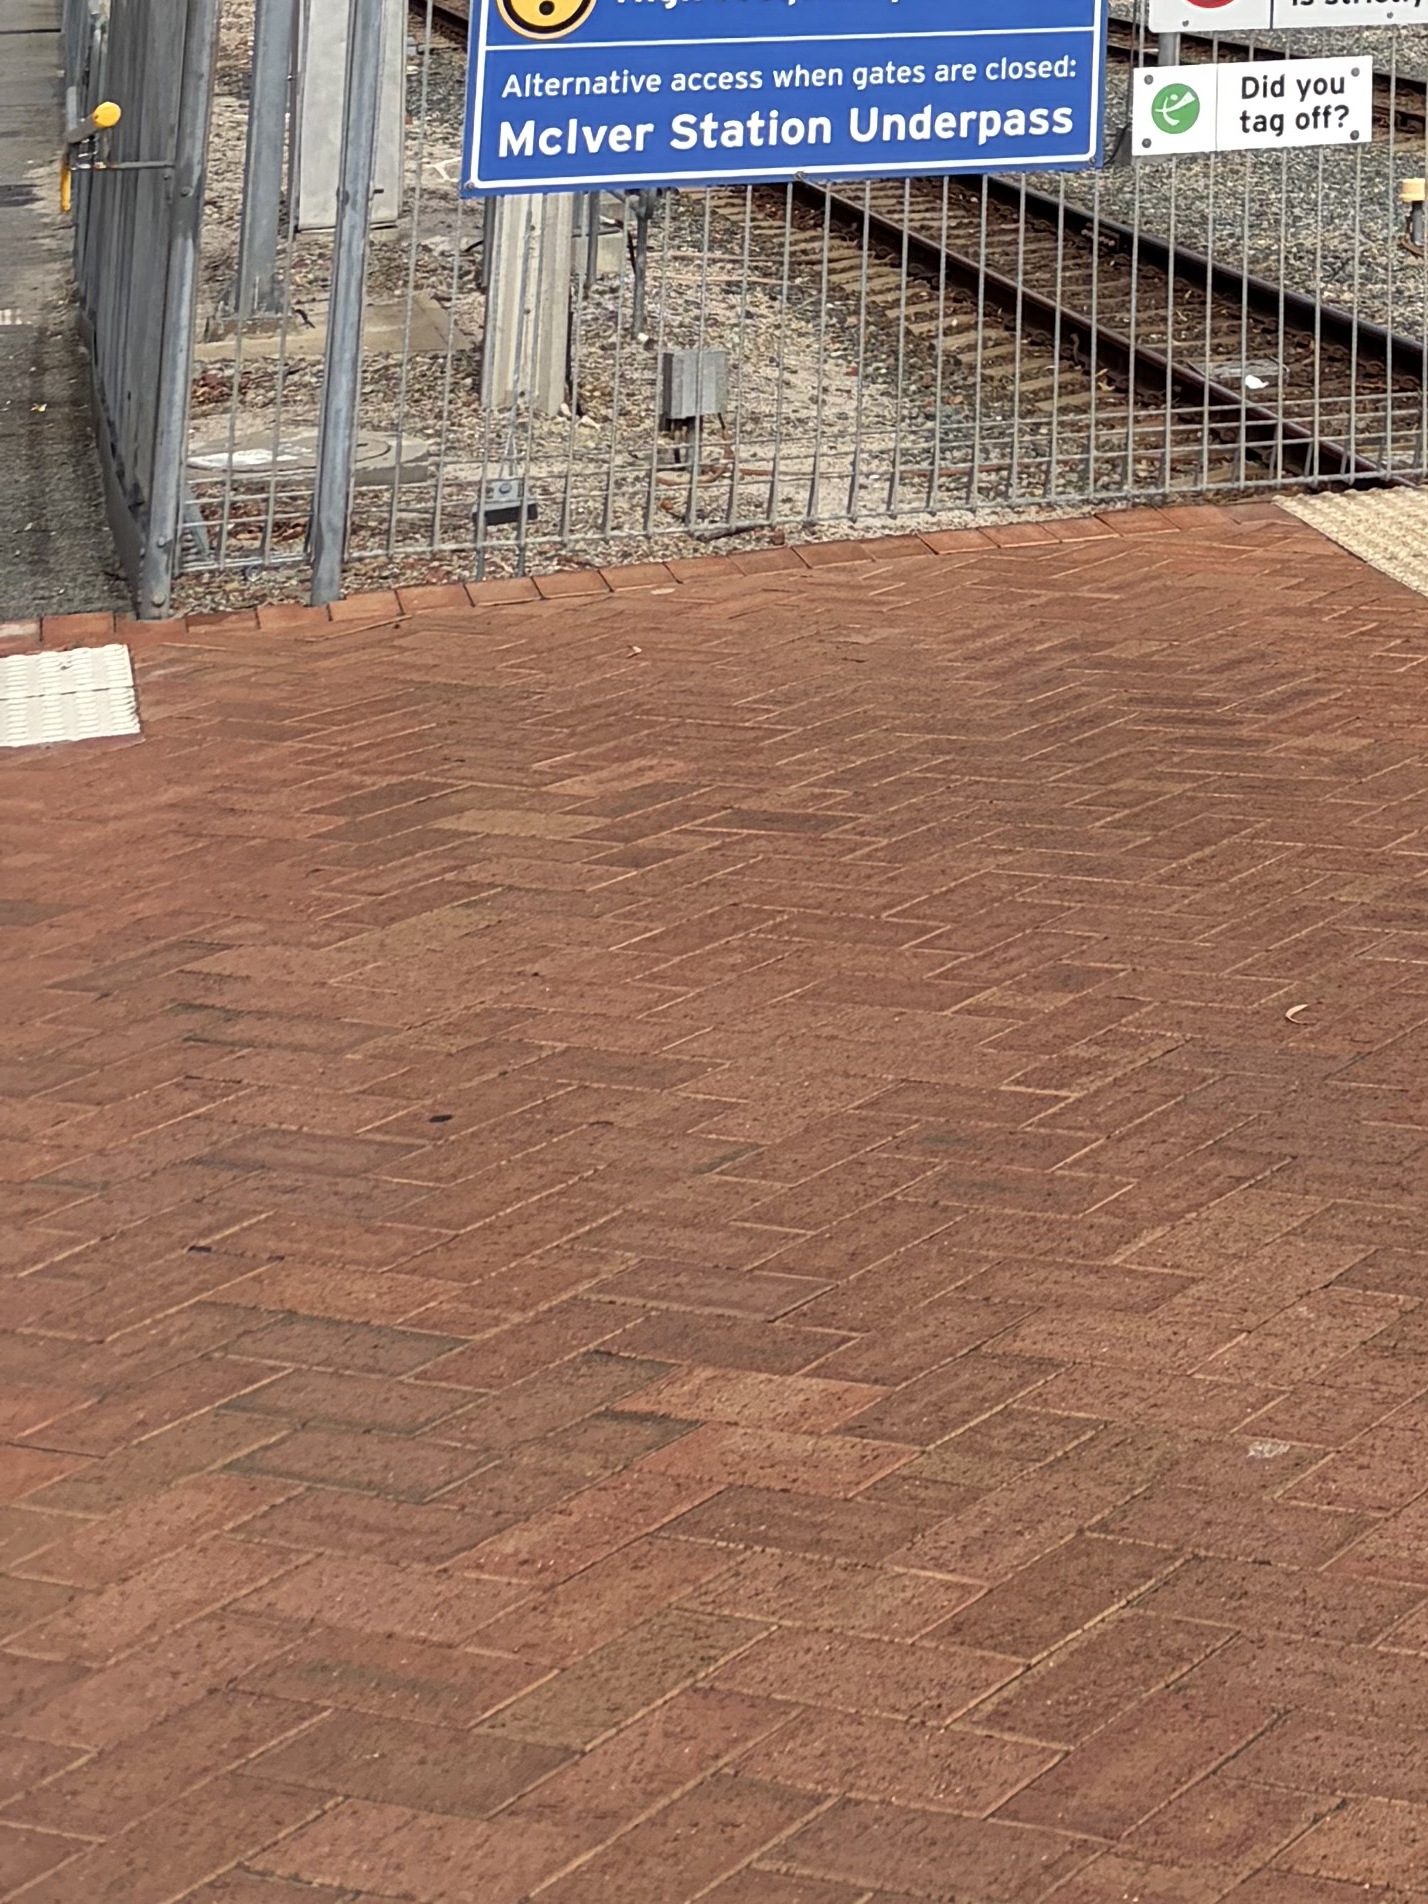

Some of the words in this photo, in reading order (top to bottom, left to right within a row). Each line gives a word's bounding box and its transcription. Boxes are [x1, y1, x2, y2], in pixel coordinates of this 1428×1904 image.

[502, 70, 661, 97] Alternative
[671, 71, 762, 91] access
[773, 65, 842, 87] when
[853, 62, 925, 90] gates
[935, 64, 976, 82] are
[986, 55, 1076, 80] closed:
[1242, 75, 1284, 99] Did
[1297, 77, 1344, 102] you
[499, 119, 654, 157] McIver
[670, 110, 831, 149] Station
[850, 105, 1072, 145] Underpass
[1240, 111, 1284, 136] tag
[1296, 105, 1349, 130] off?
